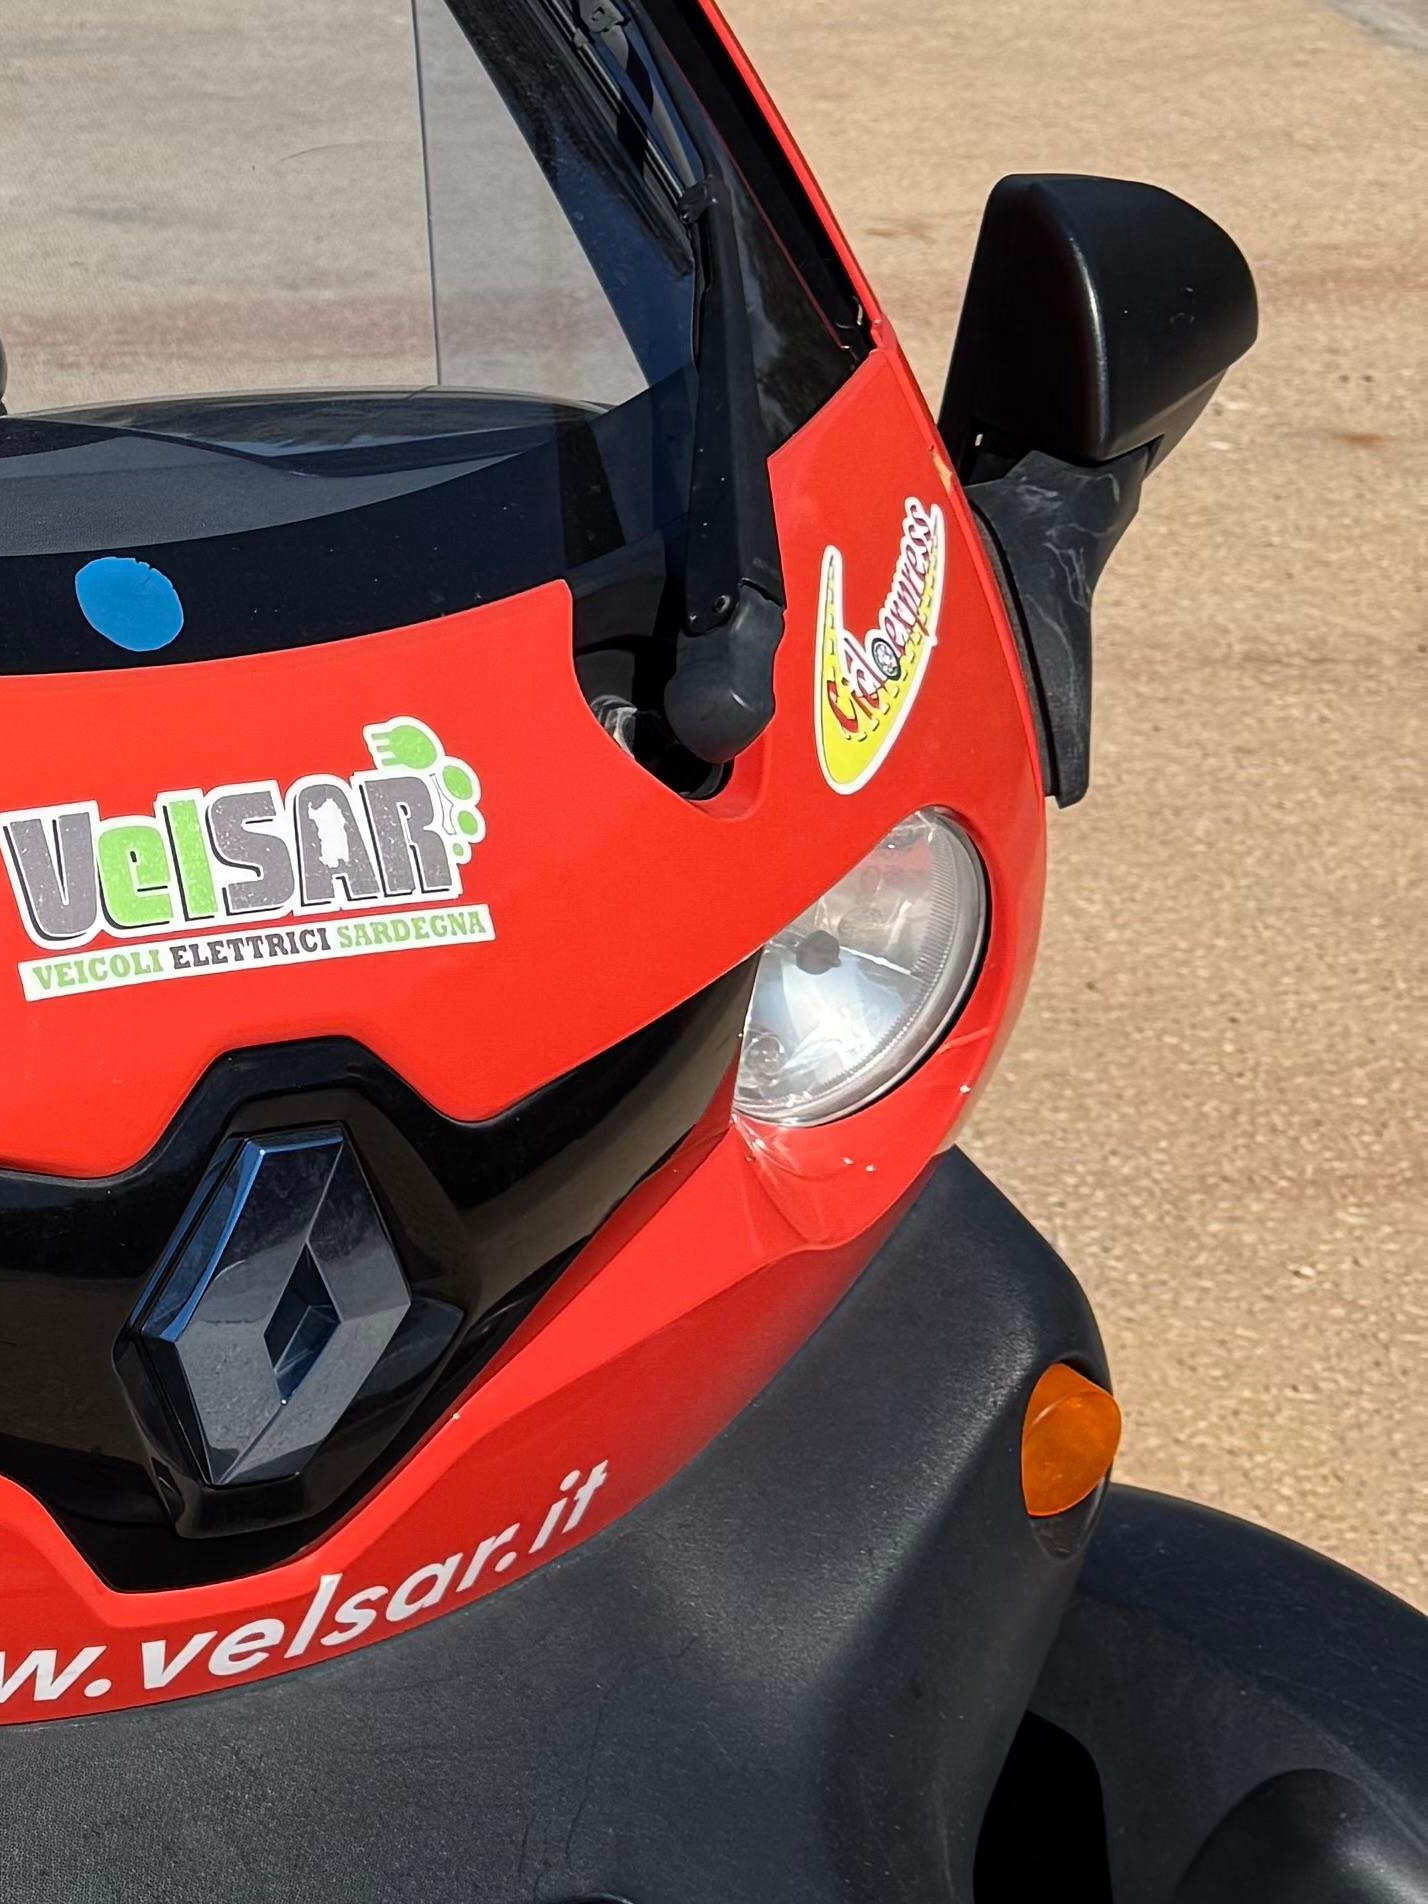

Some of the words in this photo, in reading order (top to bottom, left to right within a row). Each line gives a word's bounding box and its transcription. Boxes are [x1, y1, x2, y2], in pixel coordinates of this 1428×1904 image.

[2, 774, 455, 943] VelSAR
[31, 948, 164, 991] VEICOLI
[169, 926, 332, 971] ELETTRICI
[337, 911, 489, 949] SARDEGNA
